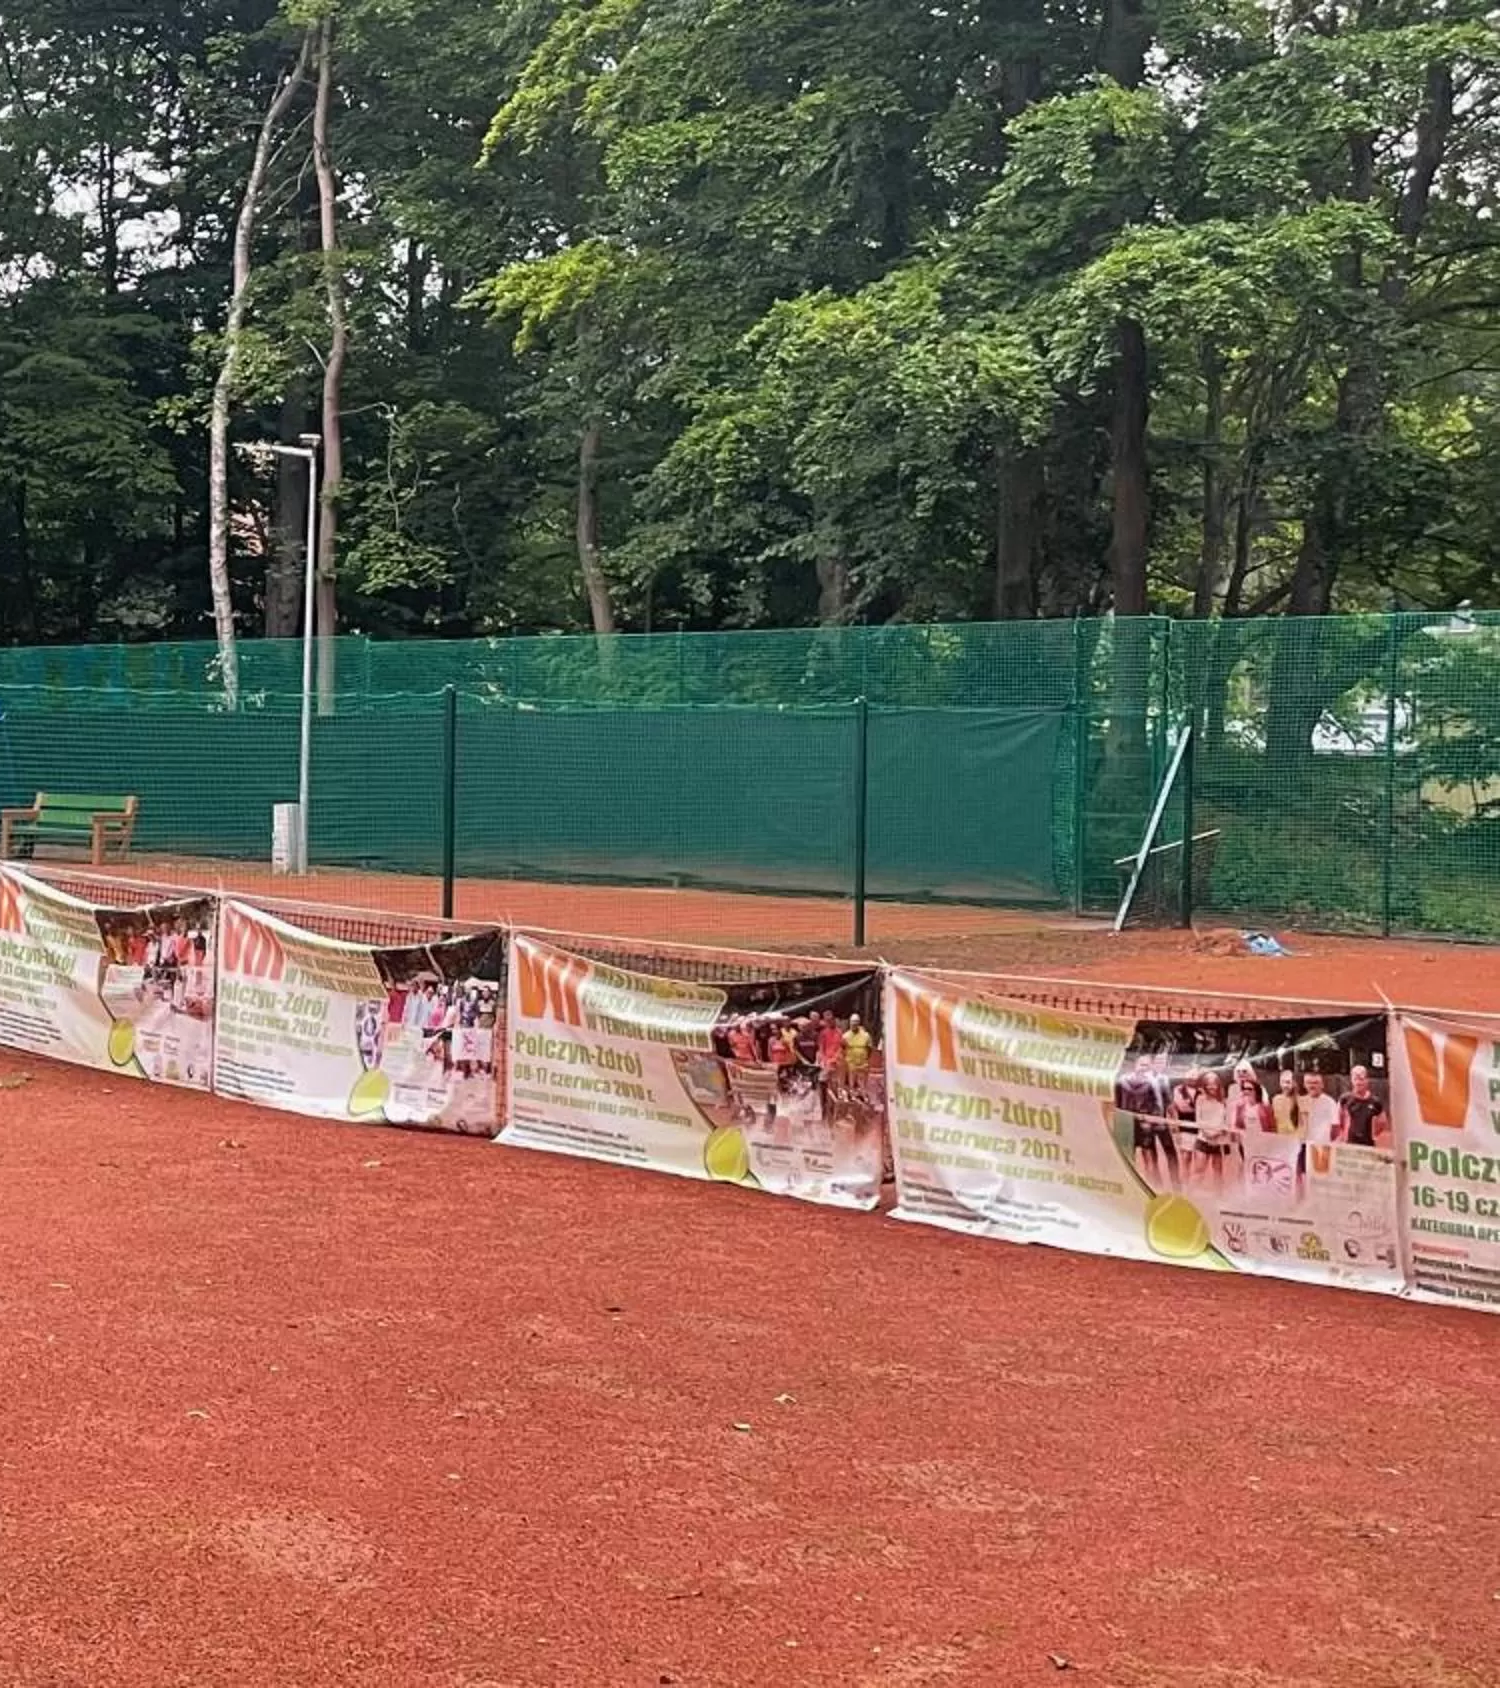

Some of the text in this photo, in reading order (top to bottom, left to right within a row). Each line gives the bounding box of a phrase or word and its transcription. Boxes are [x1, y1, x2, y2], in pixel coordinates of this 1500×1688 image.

[550, 1071, 611, 1094] czerwca
[1404, 1024, 1478, 1129] V
[1020, 1137, 1061, 1159] 2017
[1410, 1184, 1469, 1214] 16-19
